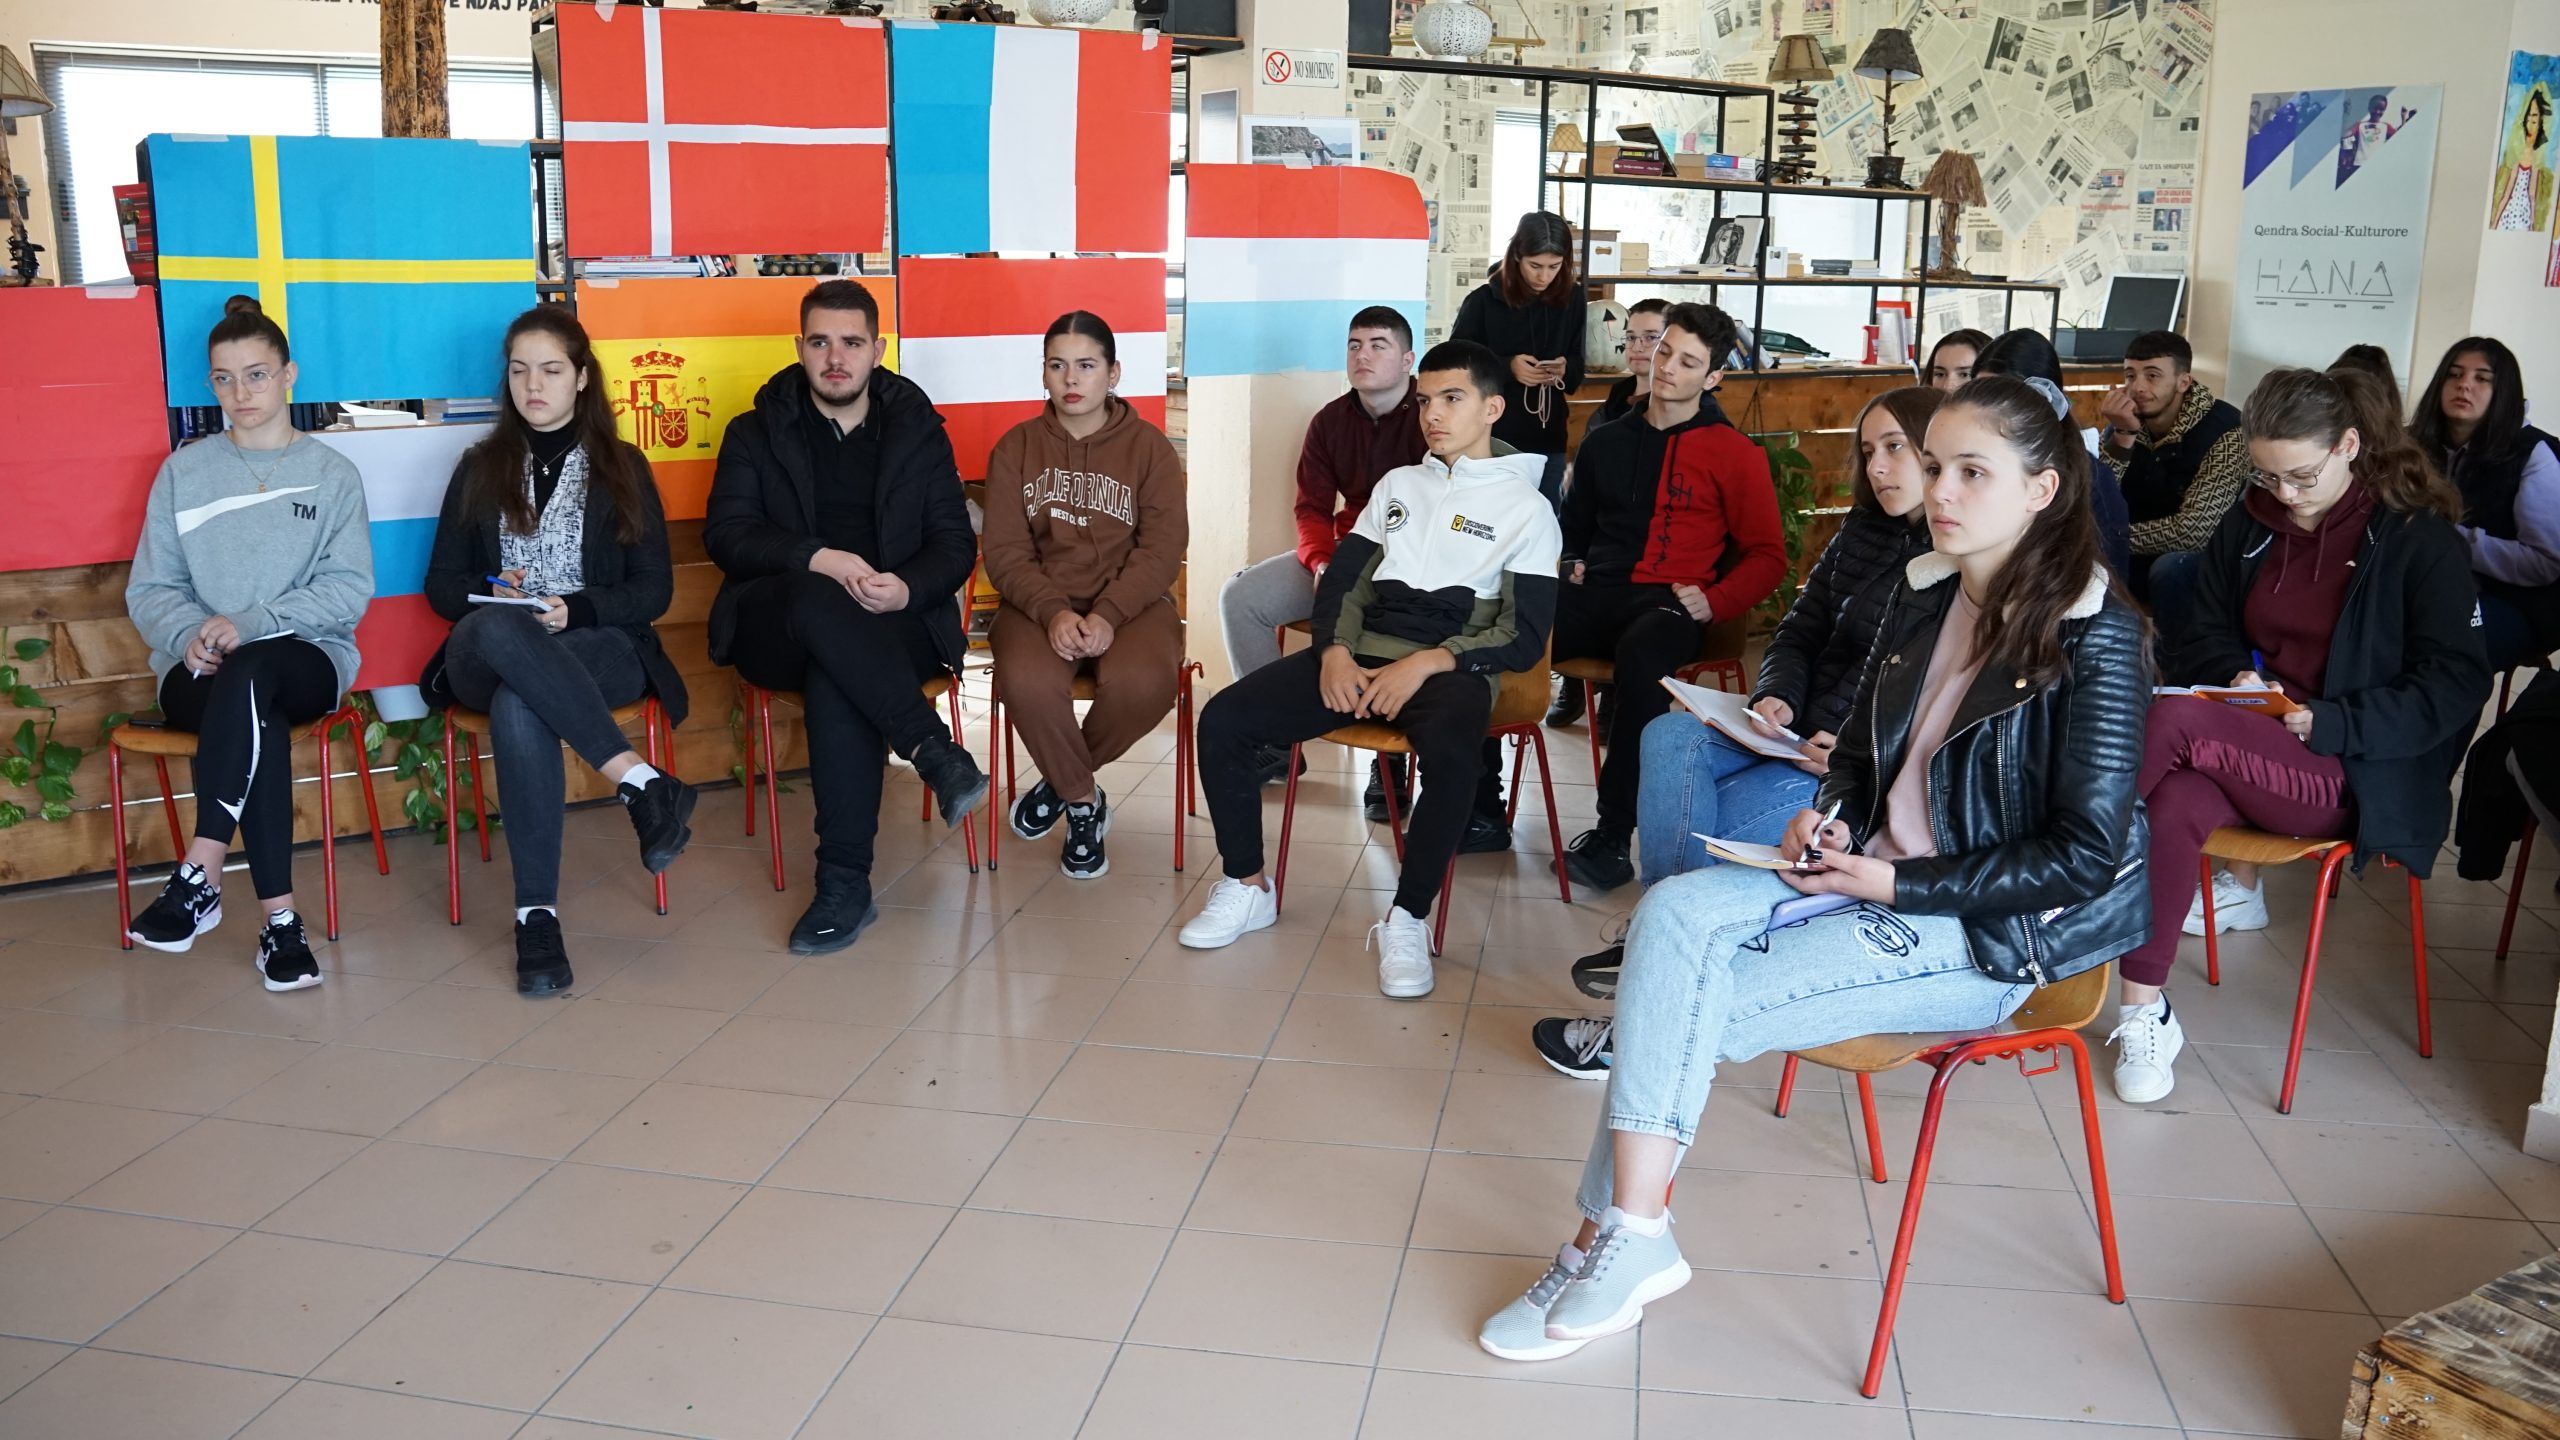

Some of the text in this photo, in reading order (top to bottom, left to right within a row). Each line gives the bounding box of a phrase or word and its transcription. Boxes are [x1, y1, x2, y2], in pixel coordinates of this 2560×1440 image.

[1665, 48, 1701, 58] OPINIONE
[1294, 60, 1334, 80] NO SMOKING
[2254, 224, 2409, 237] Qendra Social-Kulturore
[1023, 467, 1133, 526] CALIFORNIA
[292, 502, 317, 521] TM
[1050, 507, 1070, 522] WEST
[1462, 525, 1496, 542] NEW HORIZONS
[1464, 519, 1495, 534] DISCOVERING
